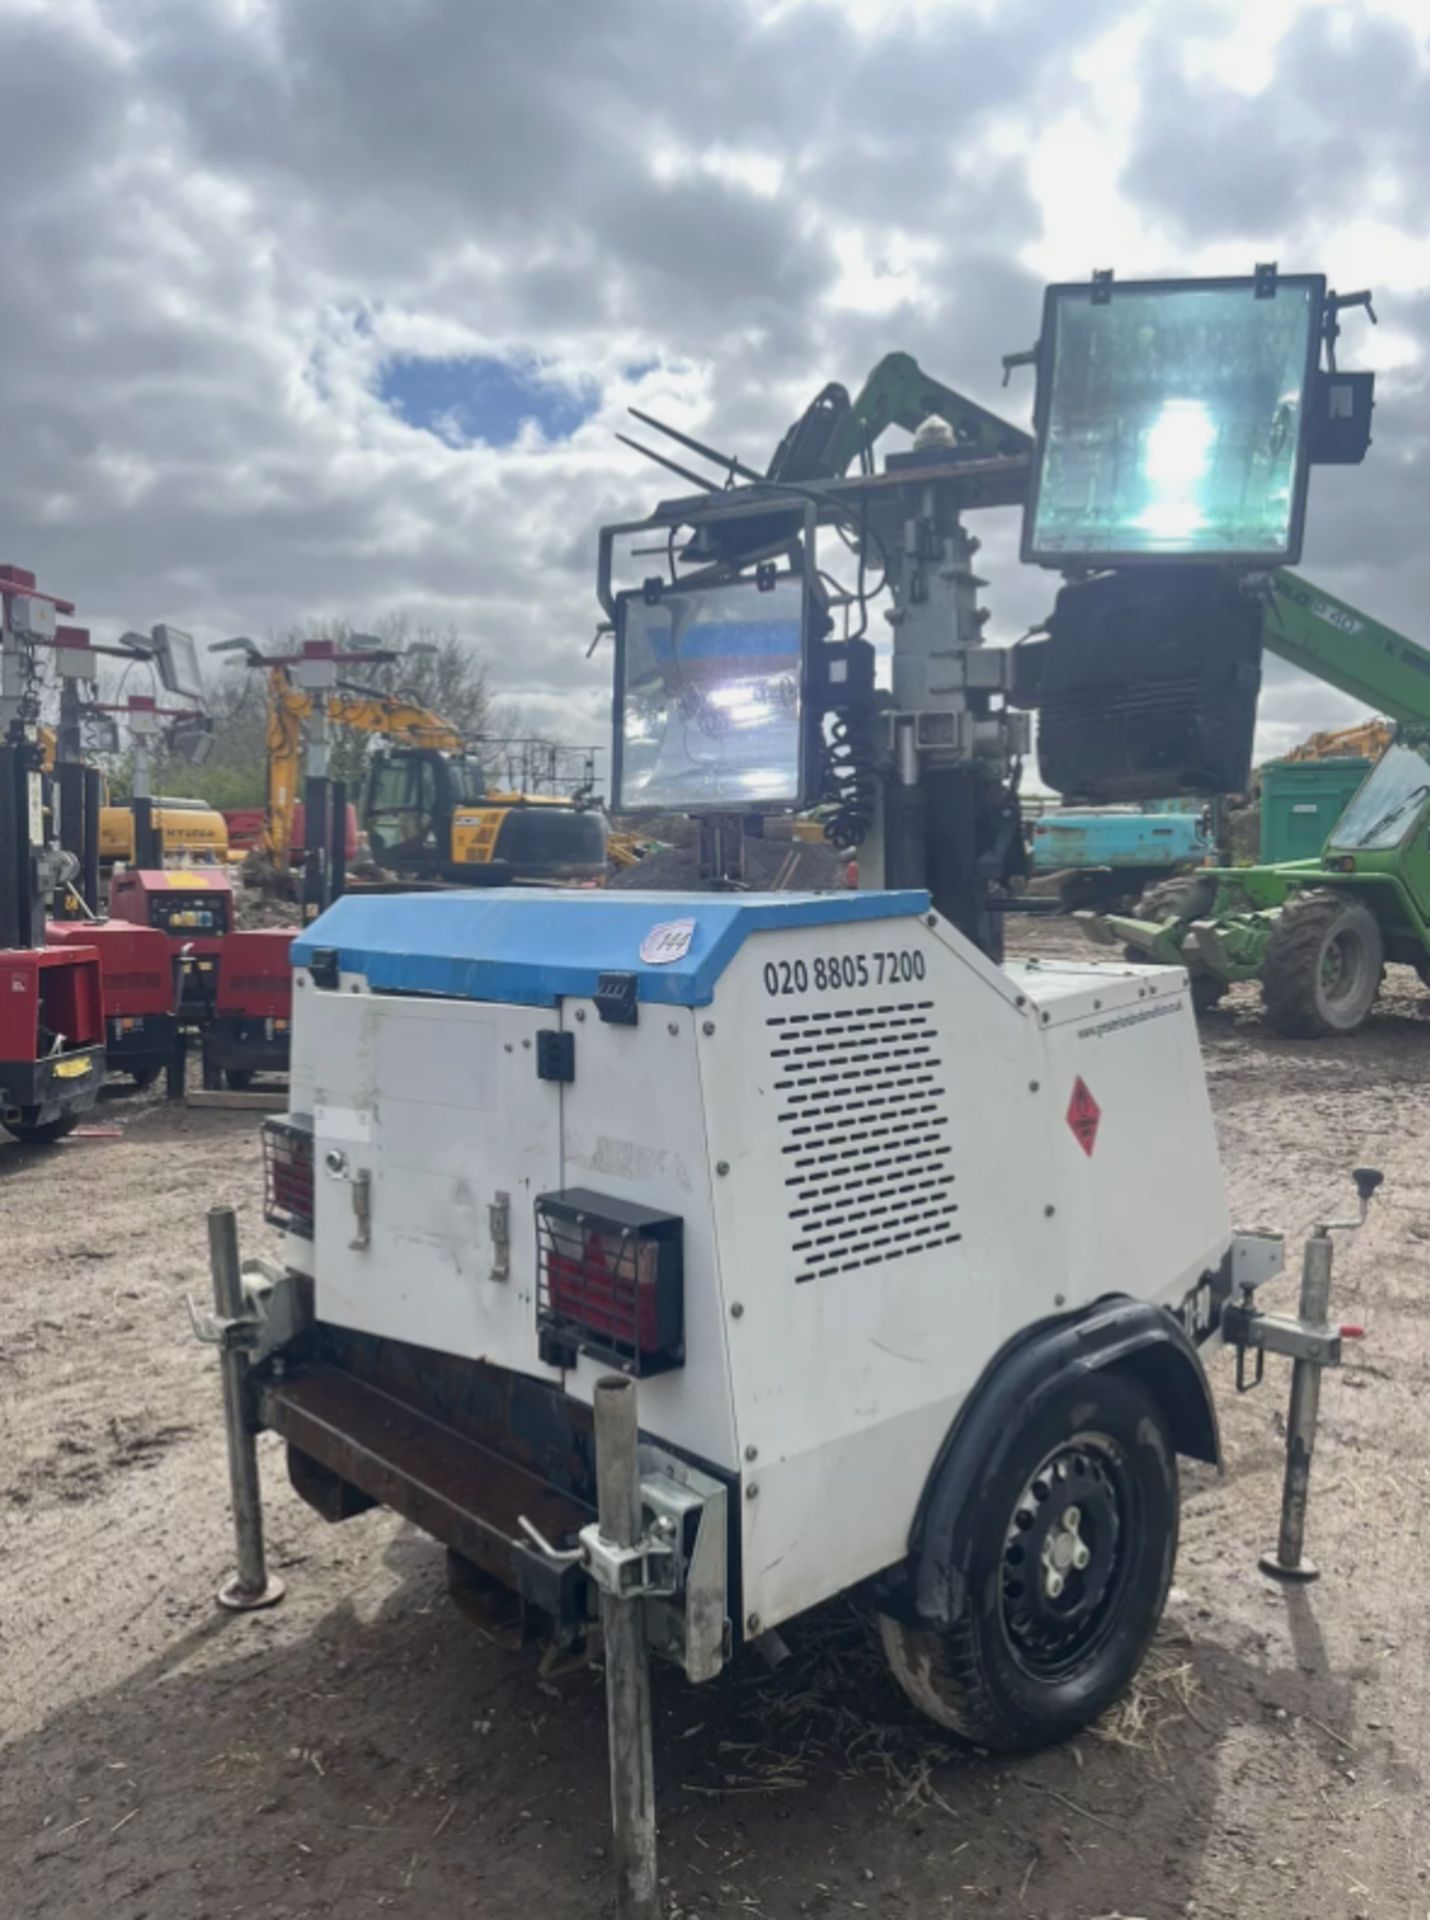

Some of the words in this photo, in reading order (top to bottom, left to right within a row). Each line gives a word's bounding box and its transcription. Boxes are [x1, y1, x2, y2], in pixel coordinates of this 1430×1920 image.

[763, 961, 808, 996] 020
[813, 954, 869, 991] 8805
[872, 949, 926, 985] 7200
